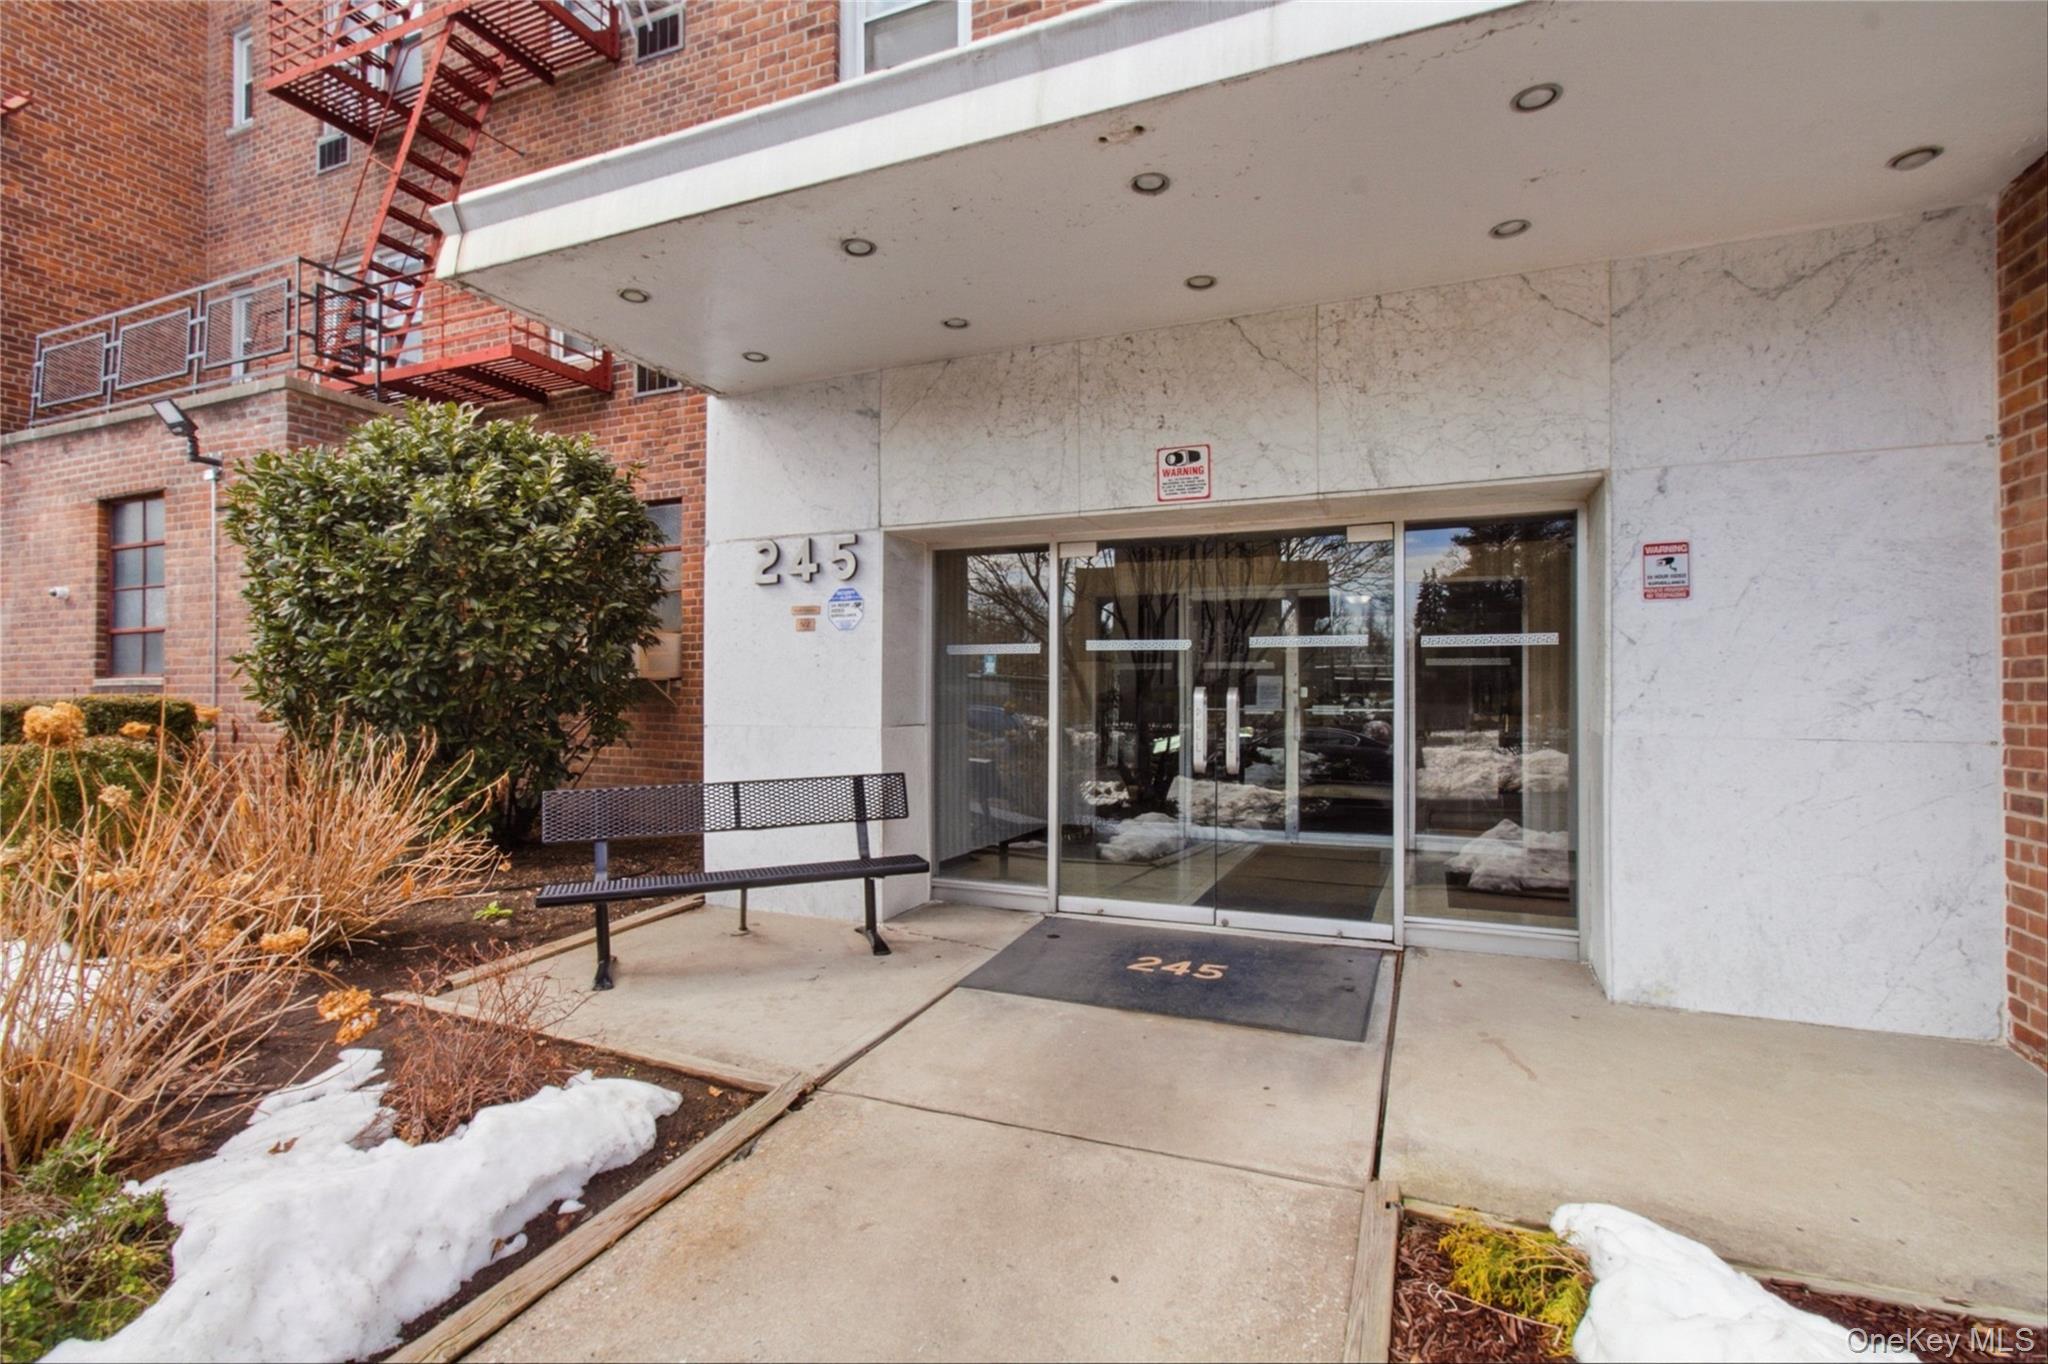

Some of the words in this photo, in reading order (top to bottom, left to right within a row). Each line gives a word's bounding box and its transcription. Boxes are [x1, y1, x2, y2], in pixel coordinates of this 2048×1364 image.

[1162, 465, 1204, 478] WARNING
[1644, 544, 1688, 555] WARNING
[755, 533, 858, 586] 245
[1125, 956, 1229, 979] 245
